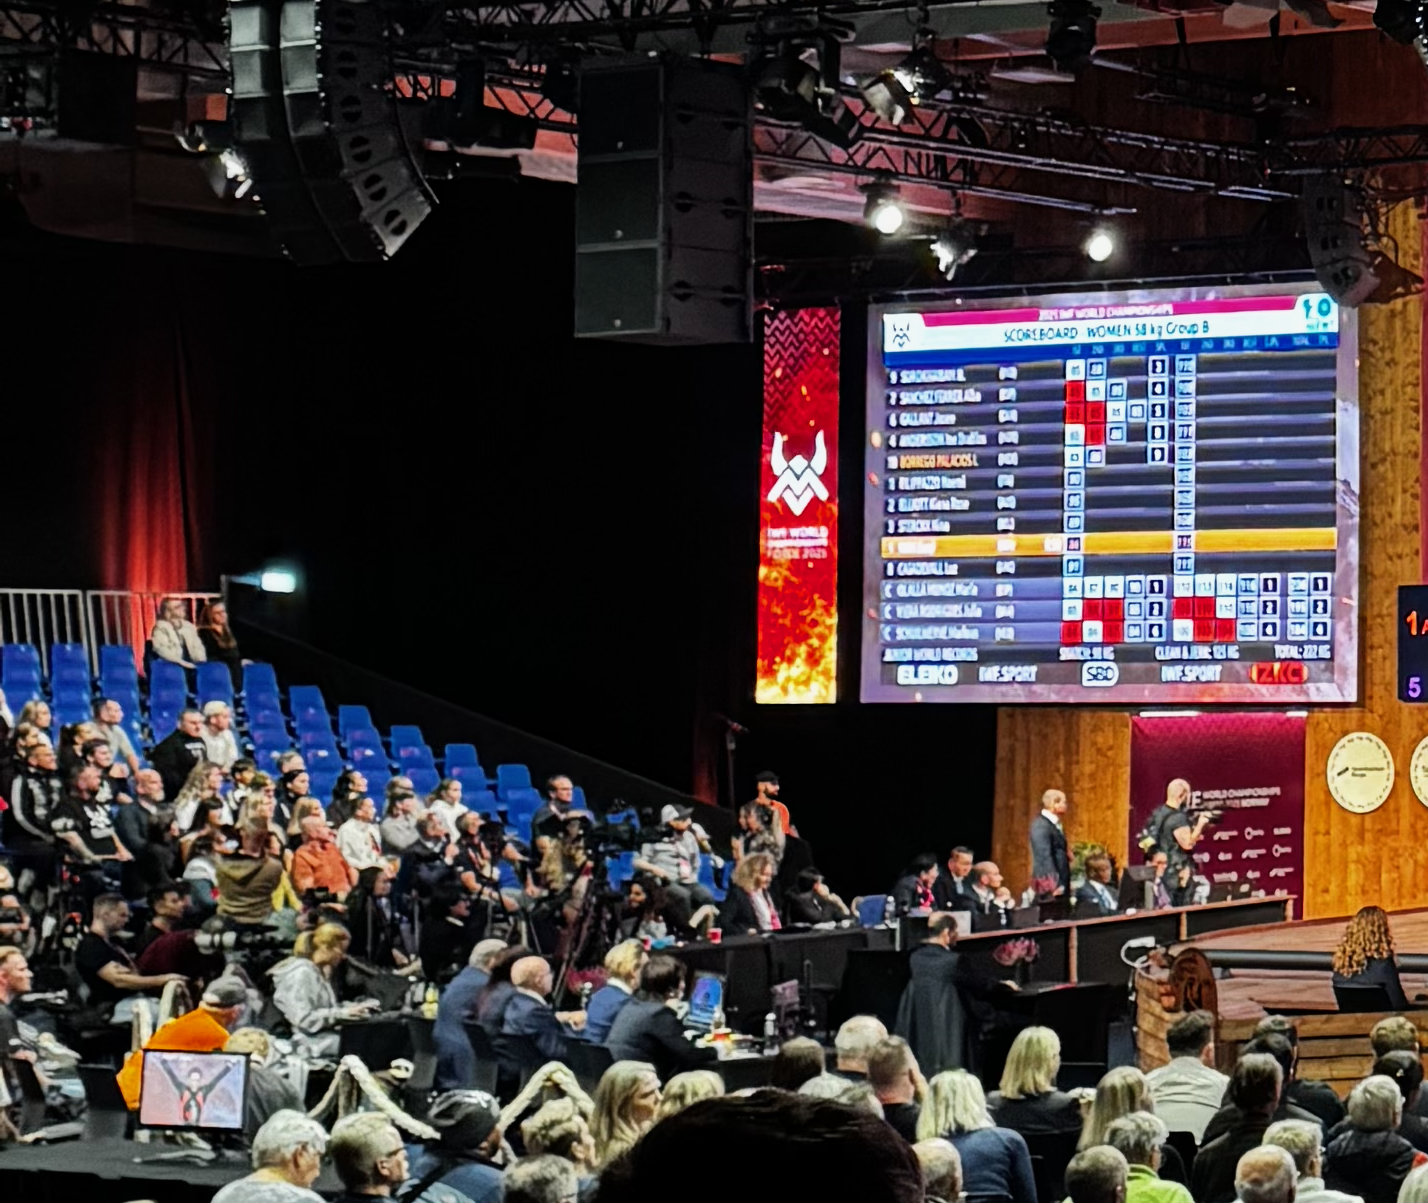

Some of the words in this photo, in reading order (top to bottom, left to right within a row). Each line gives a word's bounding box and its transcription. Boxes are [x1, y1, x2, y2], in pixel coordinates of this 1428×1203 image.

[1004, 326, 1078, 343] SCOREBOARD
[1087, 325, 1131, 339] WOMEN
[1406, 611, 1417, 635] 1
[898, 665, 958, 684] ELEIKO
[1408, 677, 1421, 698] 5
